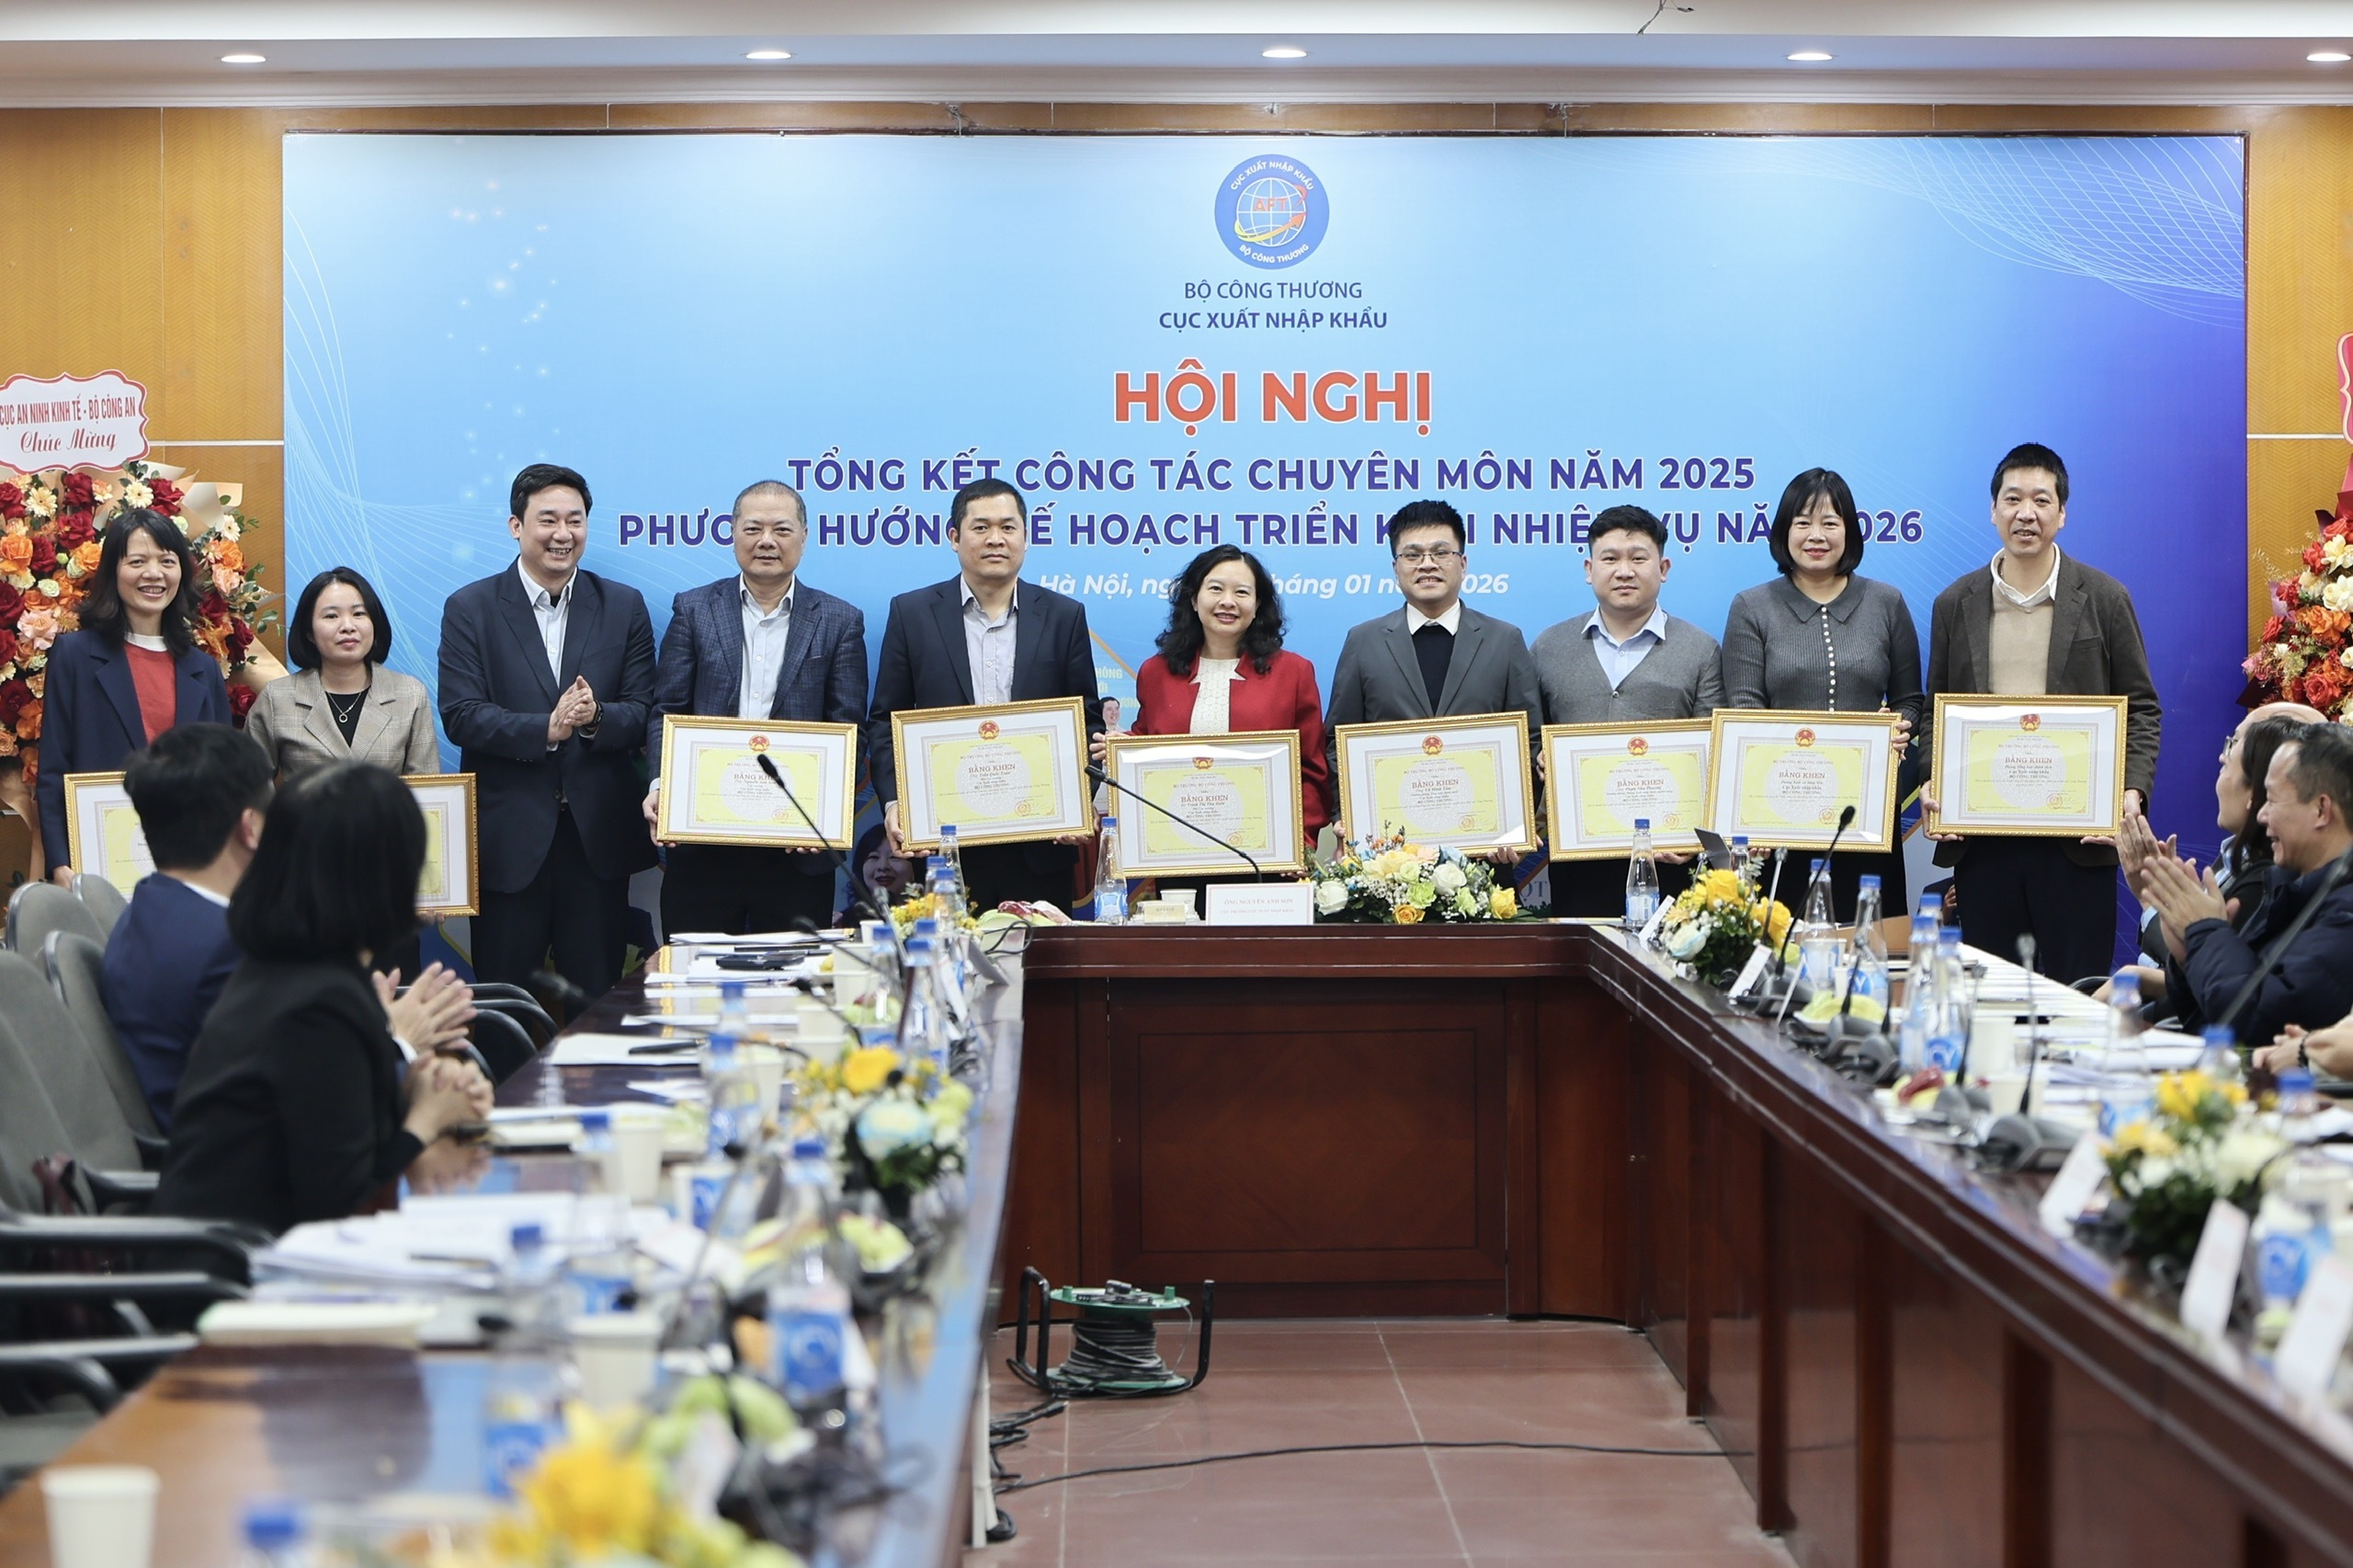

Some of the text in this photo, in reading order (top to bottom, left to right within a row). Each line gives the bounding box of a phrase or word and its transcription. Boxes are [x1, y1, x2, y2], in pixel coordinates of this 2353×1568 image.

[1230, 174, 1246, 190] CỤC
[1245, 160, 1267, 176] XUẤT
[1269, 161, 1294, 173] NHẬP
[1254, 198, 1289, 212] AFT
[1239, 244, 1310, 264] BỘ CÔNG THƯƠNG
[1185, 279, 1362, 303] BỘ CÔNG THƯƠNG
[1159, 306, 1388, 334] CỤC XUẤT NHẬP KHẨU
[0, 404, 15, 430] CỤC
[17, 403, 28, 425] AN
[29, 402, 50, 424] NINH
[51, 401, 71, 423] KINH
[72, 392, 82, 421] TẾ
[88, 394, 99, 424] BỘ
[101, 393, 122, 419] CÔNG
[125, 396, 136, 416] AN
[1113, 358, 1432, 437] HỘI NGHỊ
[20, 427, 118, 453] Chúc Mừng
[787, 446, 1756, 492] TỔNG KẾT CÔNG TÁC CHUYÊN MÔN NĂM 2025
[1027, 502, 1058, 546] Ế
[1069, 512, 1225, 555] HOẠCH
[1235, 499, 1358, 547] TRIỂN
[1376, 512, 1476, 546] KI
[1493, 504, 1601, 553] NHIỆ
[1717, 502, 1773, 544] NĂ
[1856, 509, 1924, 544] 026
[1040, 574, 1076, 595] Hà
[1083, 573, 1133, 599] Nội,
[1141, 577, 1172, 599] ng
[1271, 573, 1337, 599] háng
[1345, 574, 1371, 595] 01
[1461, 574, 1509, 594] 026
